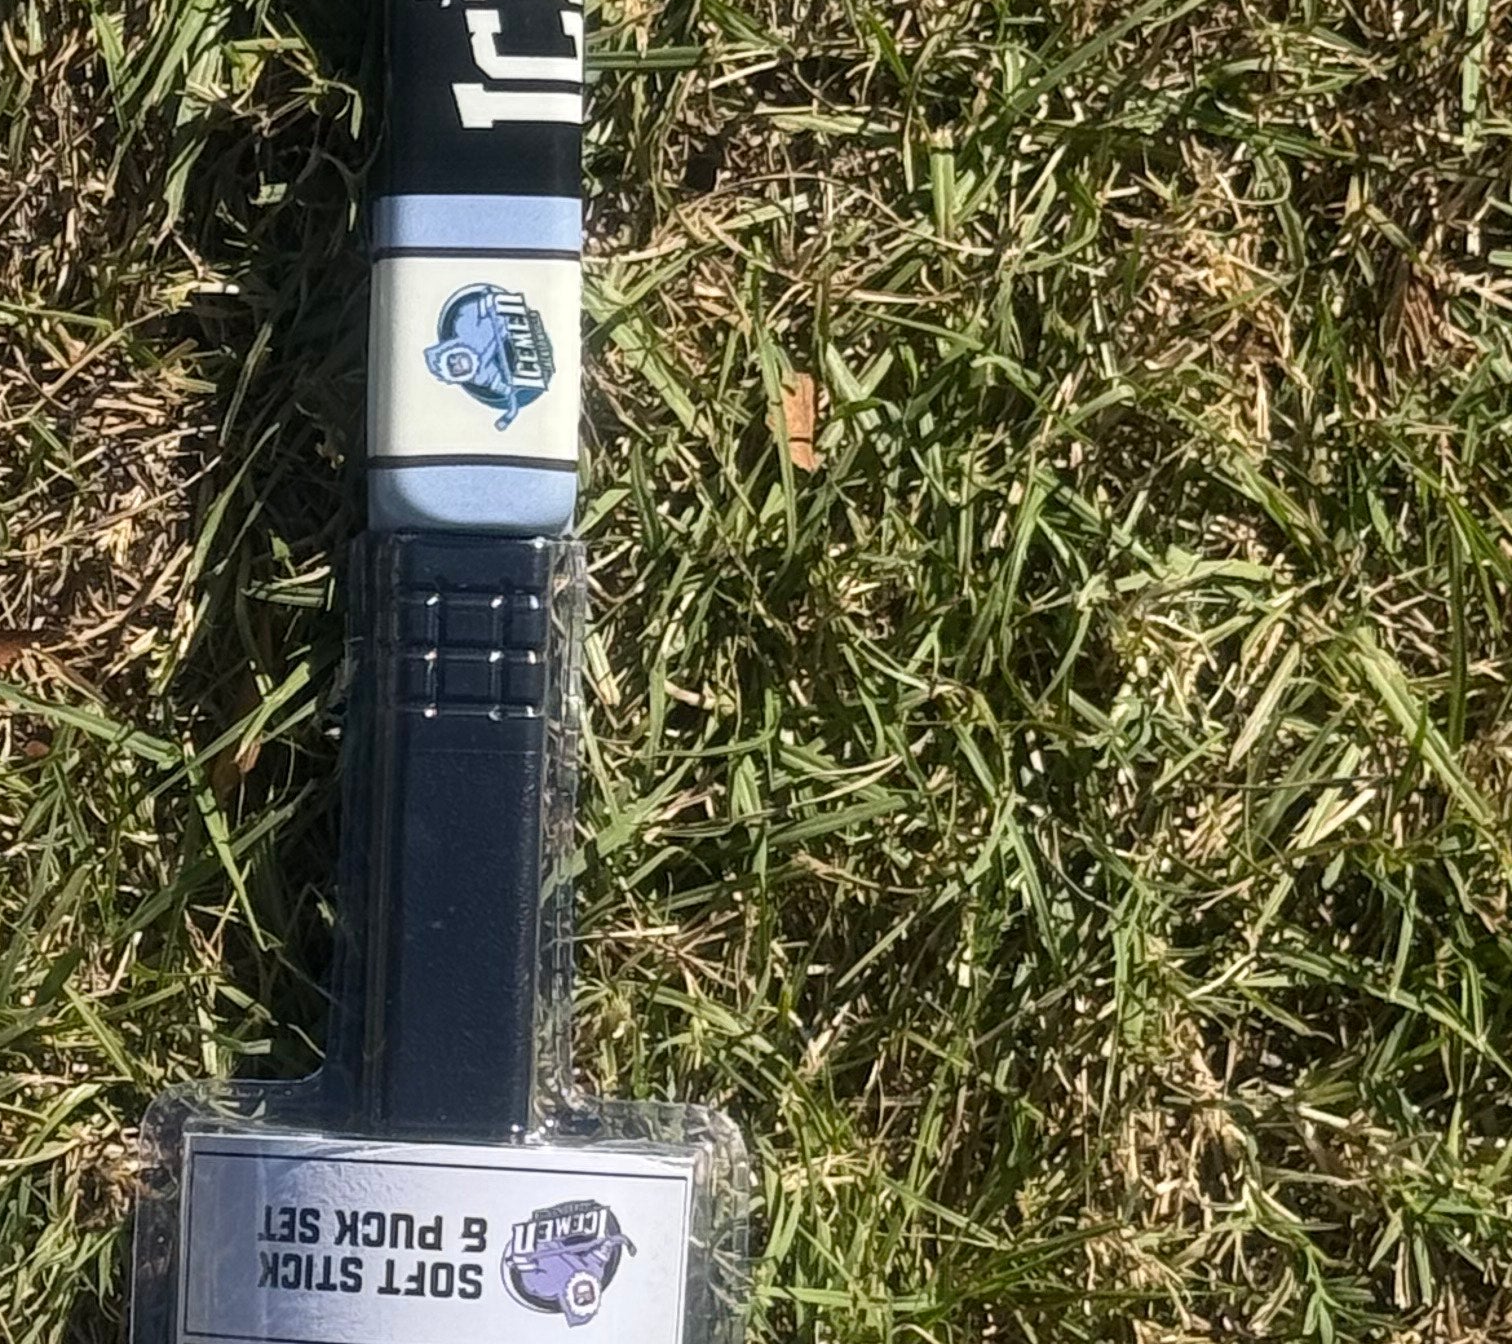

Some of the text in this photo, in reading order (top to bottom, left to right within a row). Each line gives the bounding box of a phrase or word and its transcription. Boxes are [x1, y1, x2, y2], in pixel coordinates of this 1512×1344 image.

[257, 1204, 487, 1250] & PUCK SET
[257, 1251, 483, 1299] SOFT STICK
